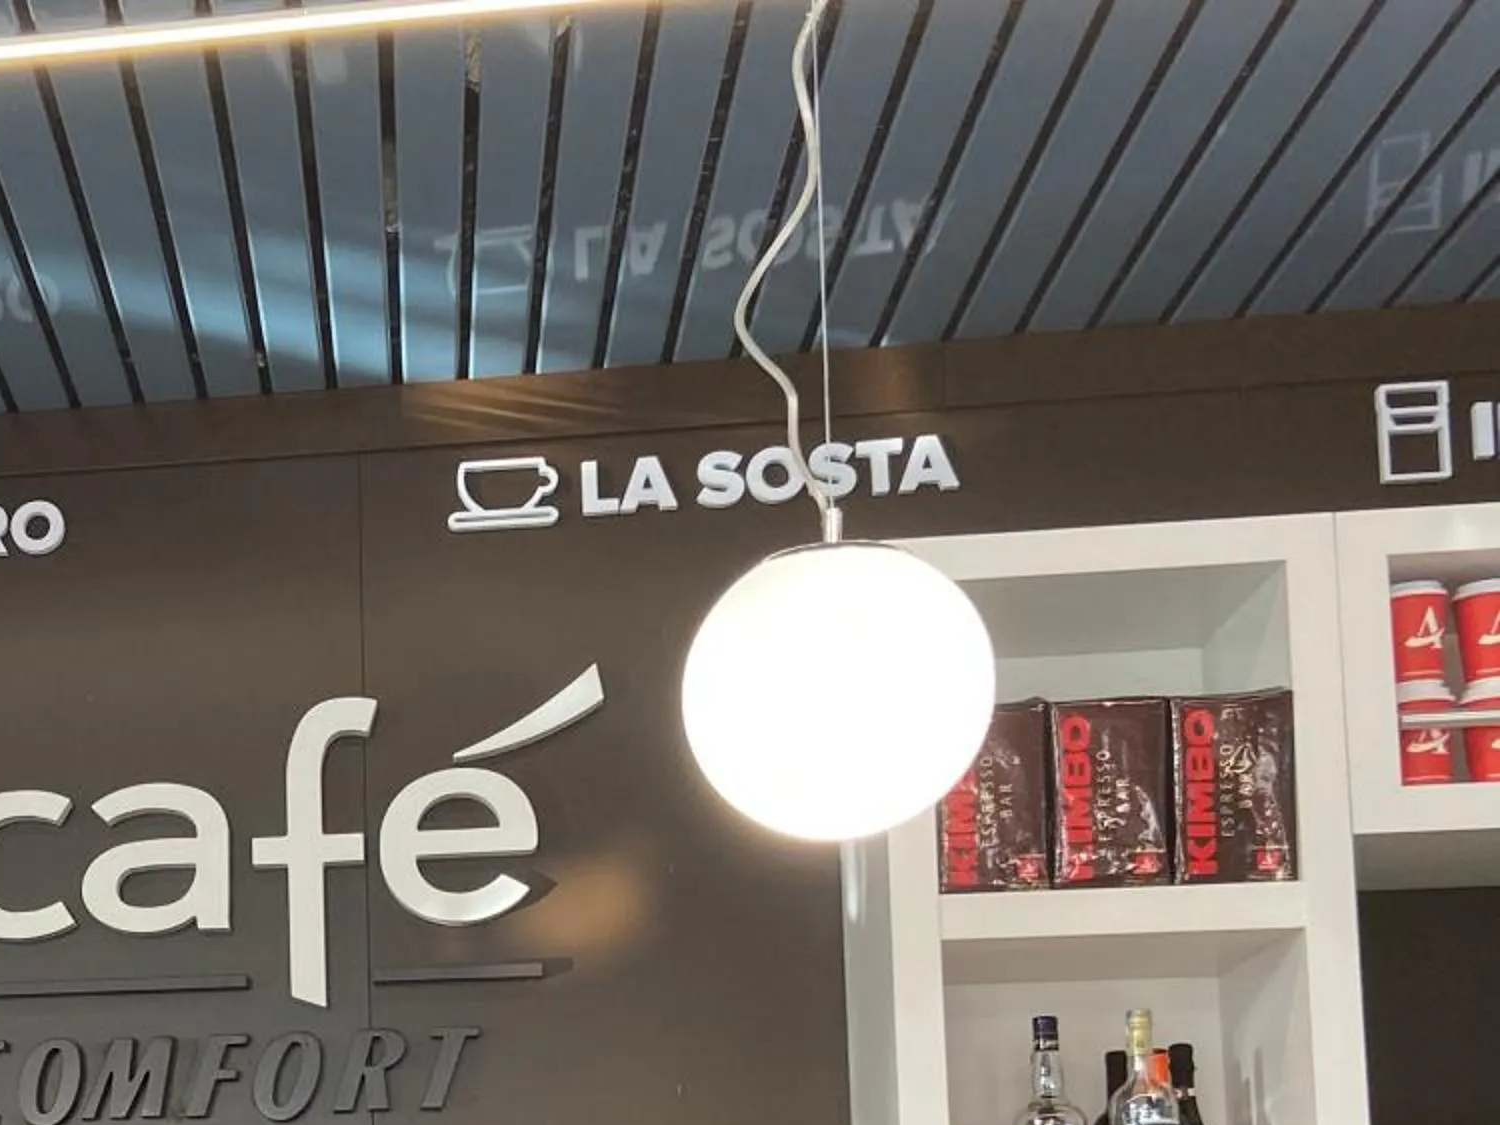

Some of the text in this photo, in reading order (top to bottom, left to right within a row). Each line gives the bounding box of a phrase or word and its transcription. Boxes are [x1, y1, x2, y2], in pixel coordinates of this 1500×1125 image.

[581, 433, 961, 517] LA SOSTA
[946, 770, 978, 885] KIM
[1060, 716, 1093, 881] KIMBO
[1184, 708, 1218, 876] KIMBO
